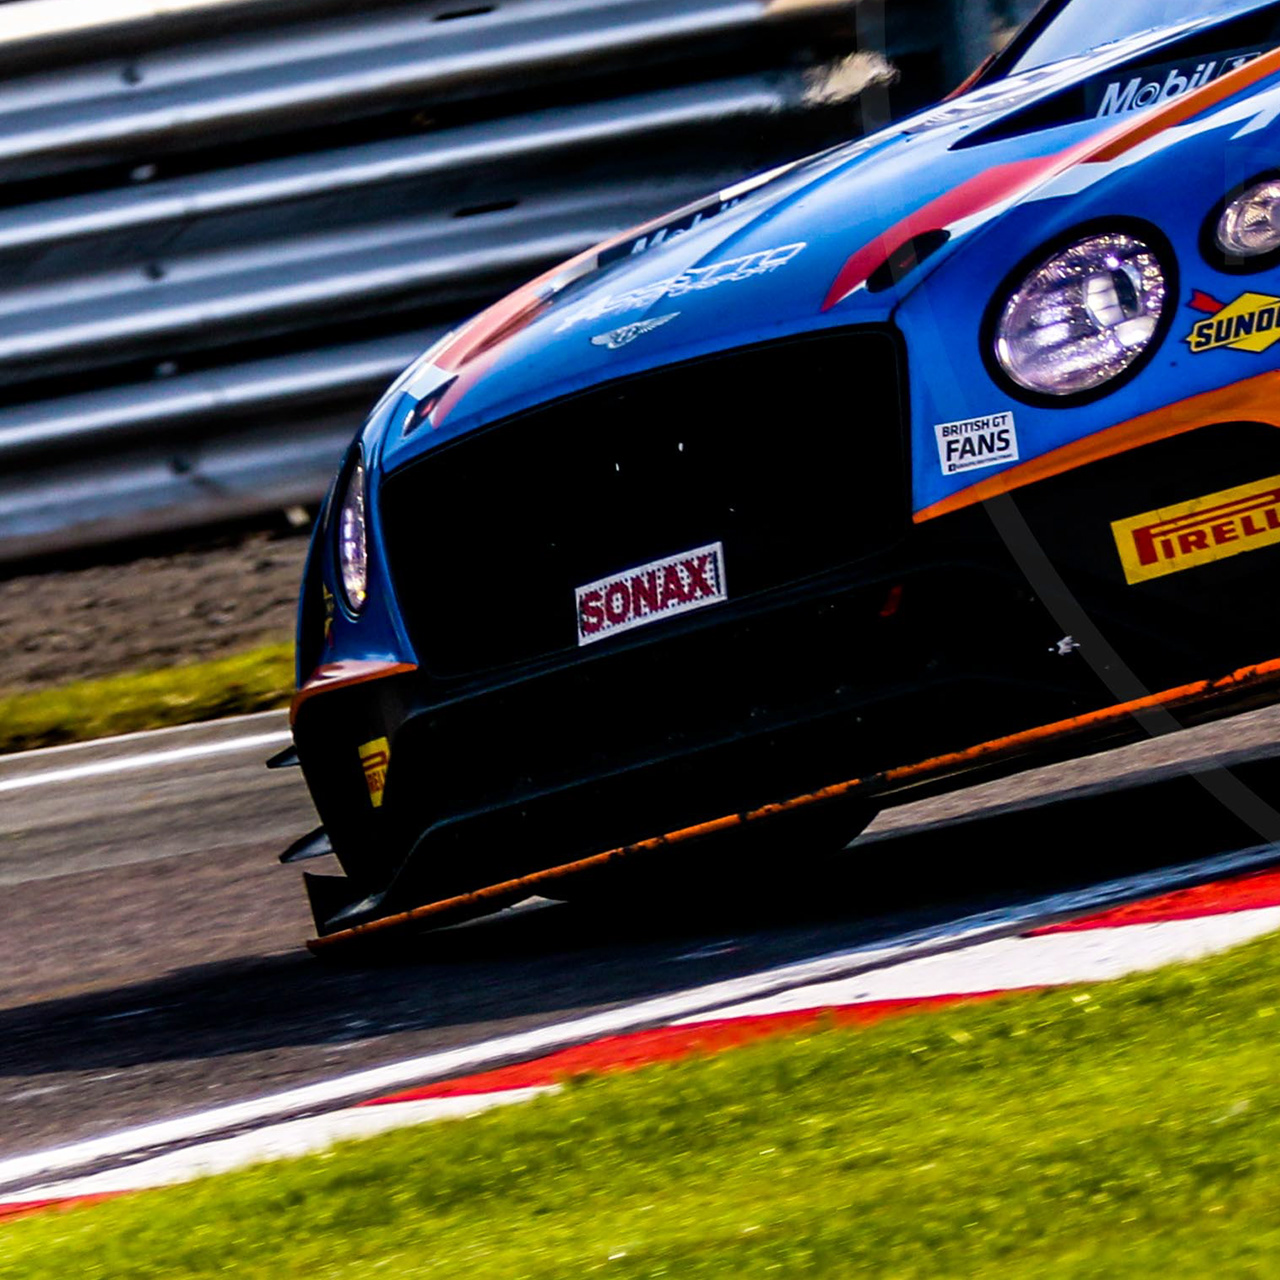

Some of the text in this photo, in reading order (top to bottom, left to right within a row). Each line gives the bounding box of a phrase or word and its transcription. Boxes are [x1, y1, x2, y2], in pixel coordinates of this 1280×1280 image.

[1096, 61, 1216, 118] Mobil
[942, 414, 1008, 437] BRITISH GT
[946, 428, 1010, 462] FANS
[582, 554, 717, 634] SONAX
